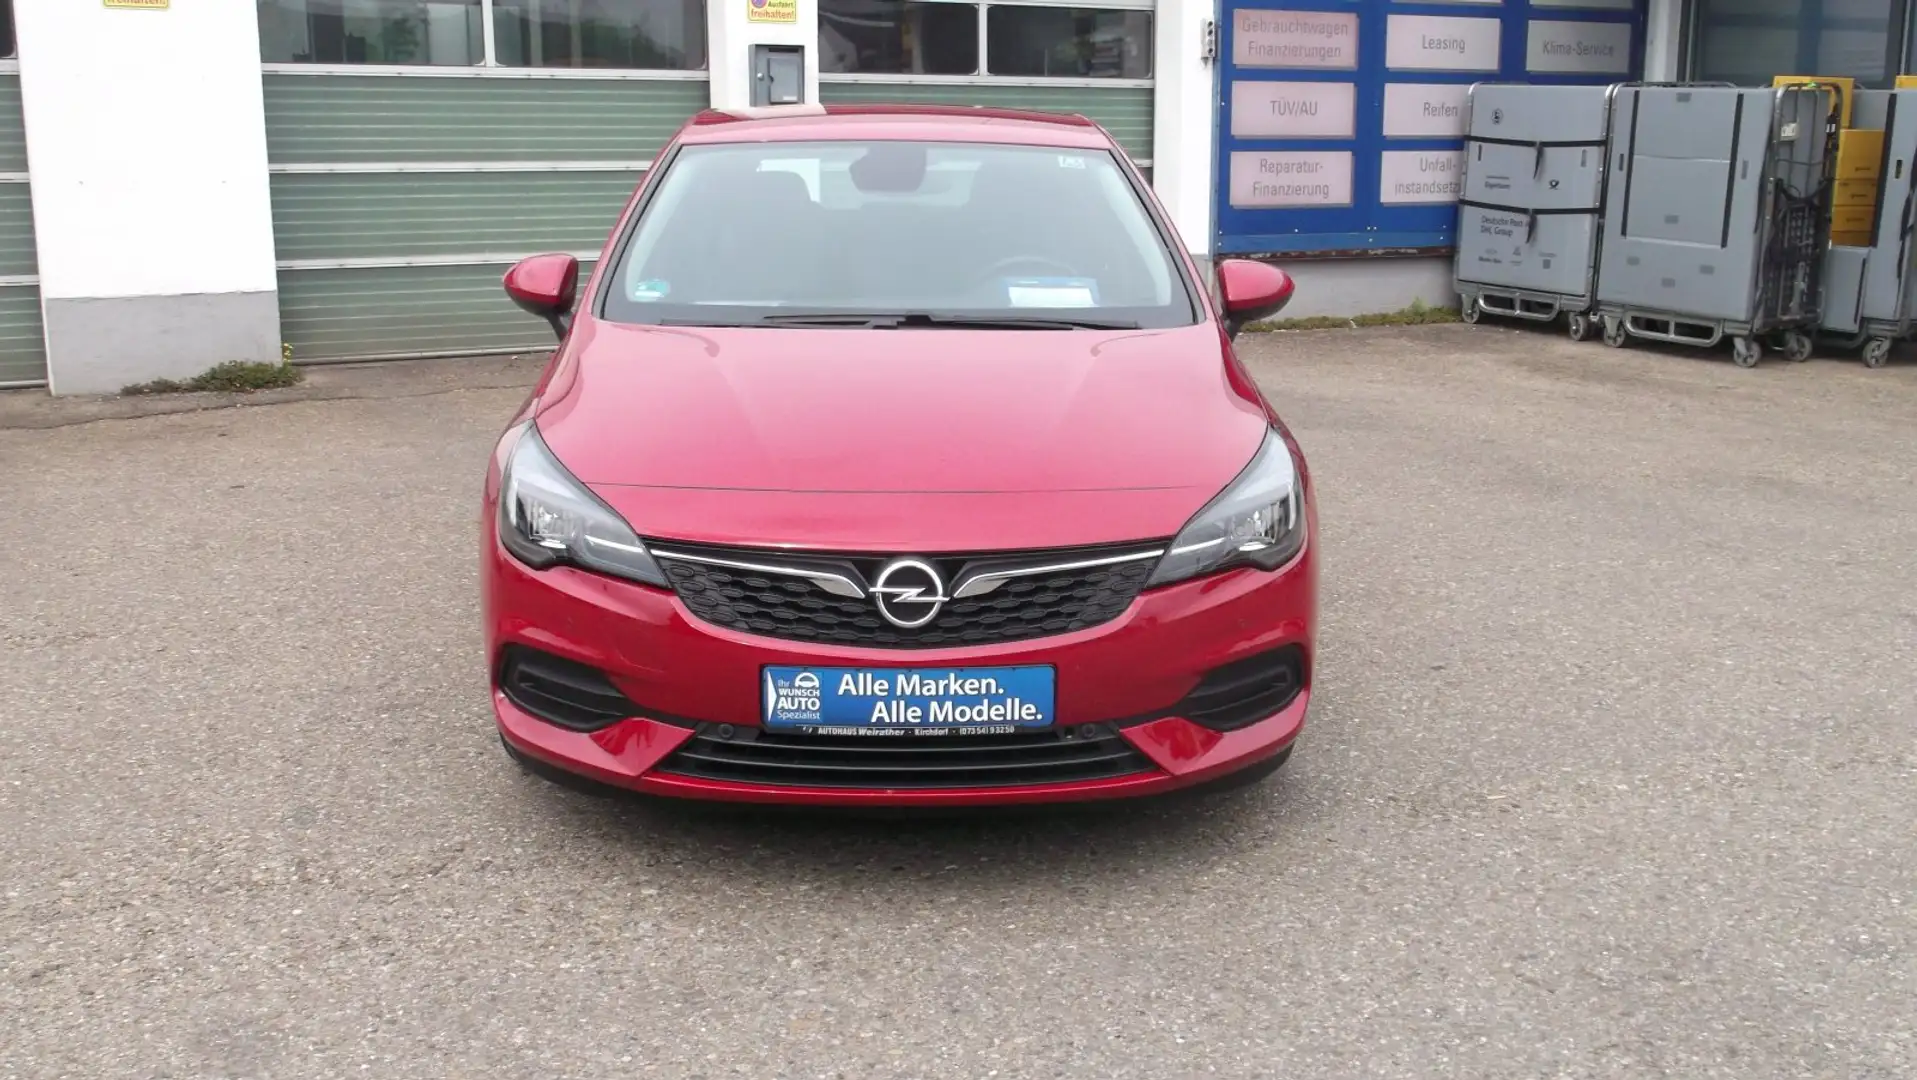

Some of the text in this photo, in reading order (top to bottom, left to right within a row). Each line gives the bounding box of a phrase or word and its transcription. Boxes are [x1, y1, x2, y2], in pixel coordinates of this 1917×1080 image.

[1242, 17, 1348, 38] Gebrauchtwagen
[1248, 40, 1341, 61] Finanzierungen
[1421, 34, 1466, 54] Leasing
[1542, 39, 1615, 57] Klima-Service
[1270, 97, 1318, 117] TÜV/AU
[1423, 101, 1458, 117] Reifen
[1260, 158, 1324, 177] Reparatur-
[1420, 156, 1457, 172] Unfall-
[1252, 181, 1329, 199] Finanzierung
[778, 687, 820, 697] WUNSCH
[837, 672, 1005, 696] Alle Marken.
[777, 696, 820, 710] AUTO
[870, 697, 1043, 723] Alle Modelle.
[777, 710, 821, 720] Spezialist
[818, 727, 857, 736] AUTOHAUS
[858, 727, 905, 736] Weirather
[914, 727, 949, 736] Kirchdorf
